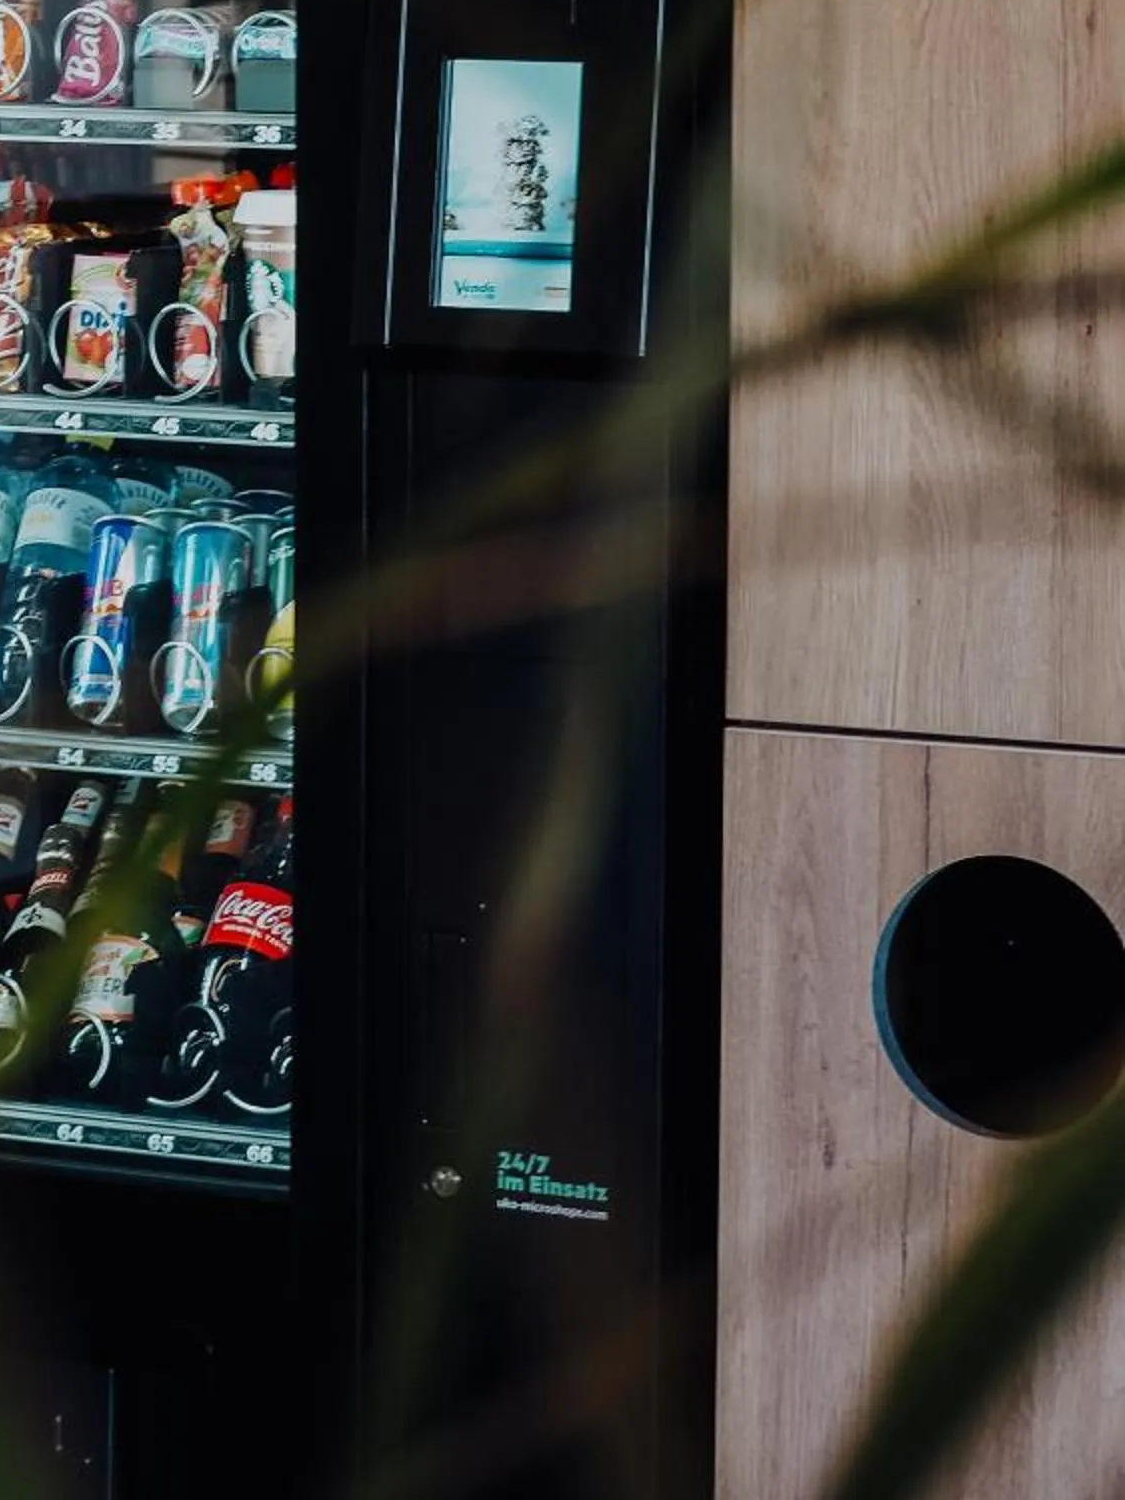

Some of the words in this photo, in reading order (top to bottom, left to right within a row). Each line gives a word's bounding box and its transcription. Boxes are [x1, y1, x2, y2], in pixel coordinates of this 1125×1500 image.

[59, 119, 87, 136] 34
[152, 122, 180, 140] 35
[253, 125, 281, 143] 36
[55, 412, 83, 429] 44
[152, 417, 180, 435] 45
[251, 422, 279, 441] 46
[57, 748, 85, 765] 54
[152, 756, 179, 773] 55
[249, 764, 277, 781] 56
[57, 1124, 83, 1142] 64
[147, 1134, 175, 1153] 65
[247, 1145, 274, 1163] 66
[497, 1151, 550, 1174] 24/7
[497, 1170, 525, 1191] im
[528, 1175, 609, 1201] Einsatz
